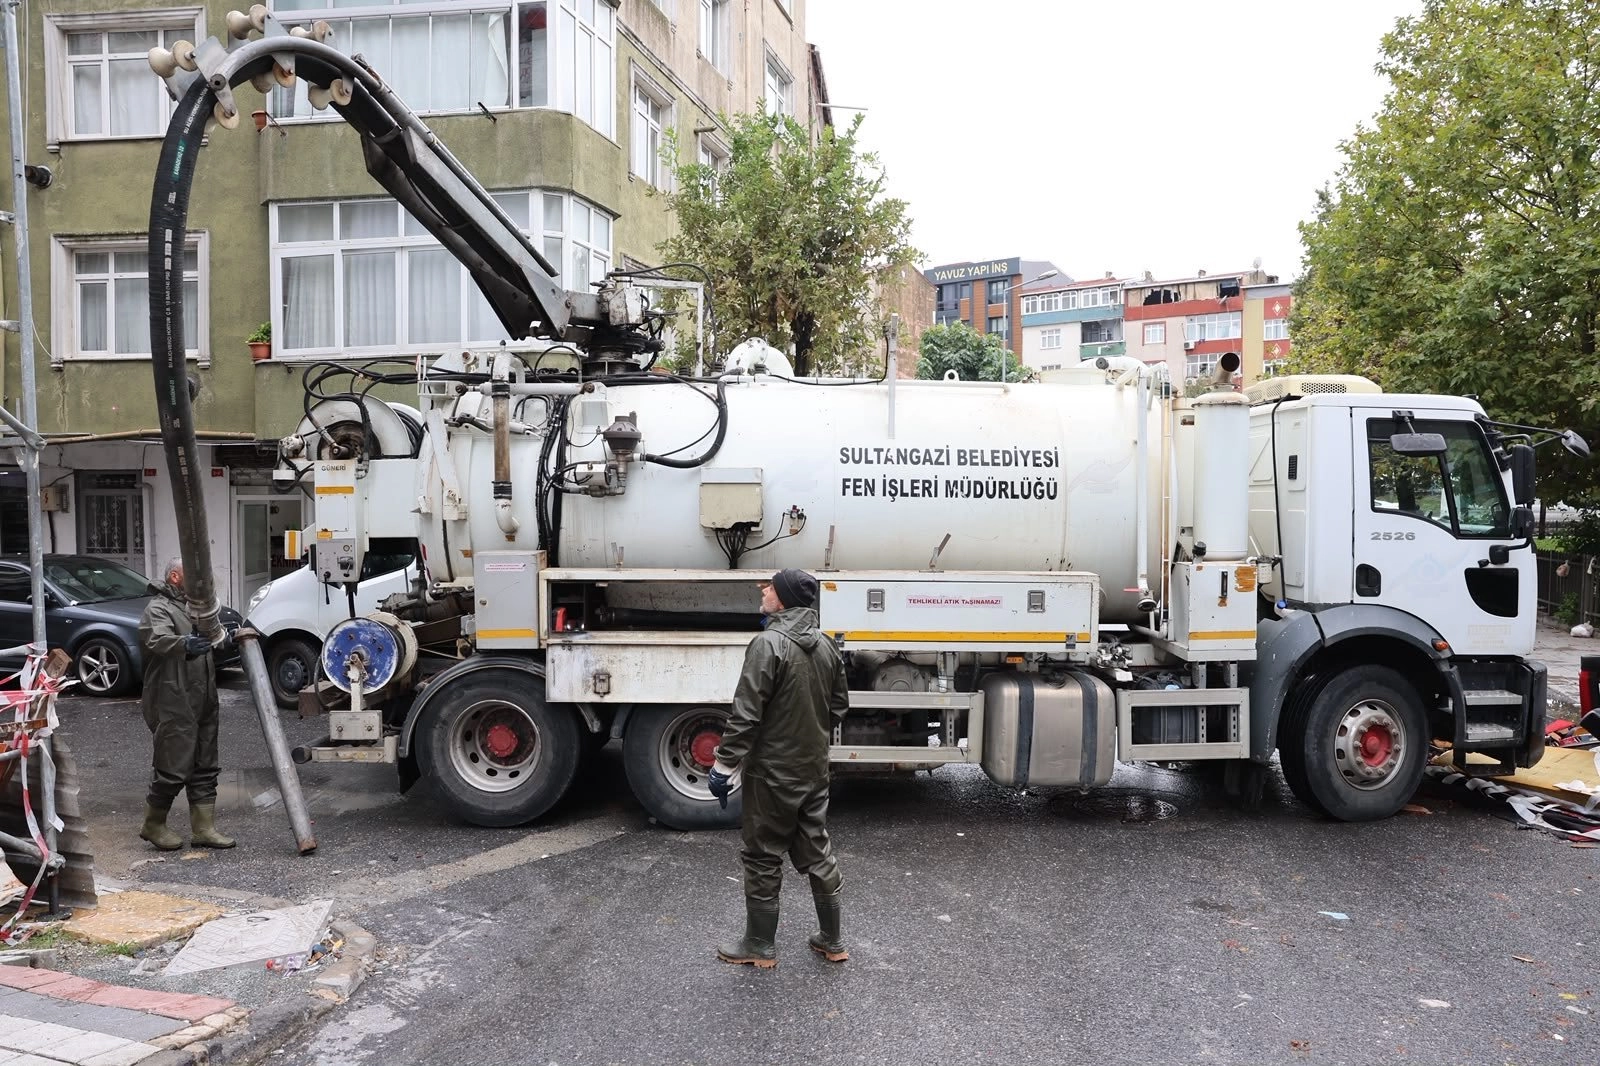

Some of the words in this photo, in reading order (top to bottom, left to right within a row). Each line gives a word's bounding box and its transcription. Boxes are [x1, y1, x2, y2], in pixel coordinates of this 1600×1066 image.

[934, 268, 966, 281] YAVUZ
[967, 264, 990, 276] YAPI
[991, 261, 1008, 275] İNŞ
[839, 445, 950, 466] SULTANGAZİ
[957, 446, 1059, 467] BELEDİYESİ
[842, 478, 875, 497] FEN
[882, 474, 939, 502] İŞLERİ
[945, 476, 1058, 500] MÜDÜRLÜĞÜ
[1370, 531, 1416, 541] 2526
